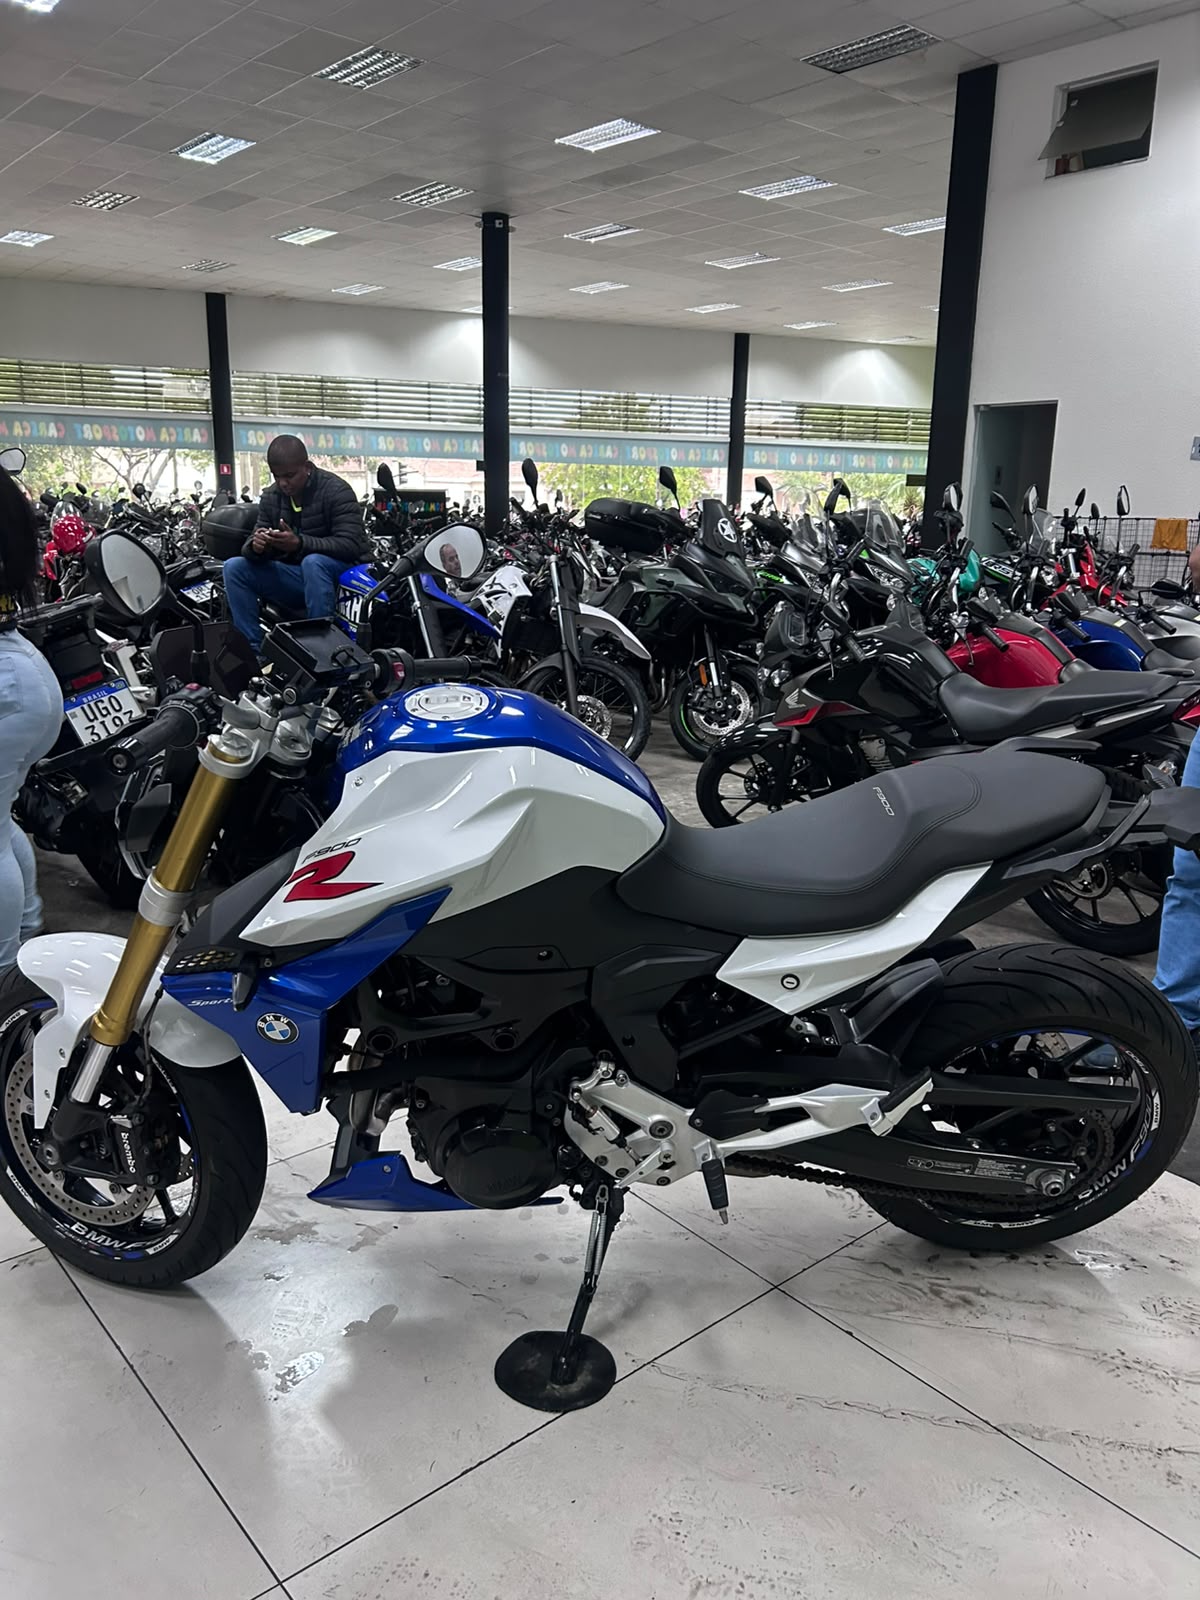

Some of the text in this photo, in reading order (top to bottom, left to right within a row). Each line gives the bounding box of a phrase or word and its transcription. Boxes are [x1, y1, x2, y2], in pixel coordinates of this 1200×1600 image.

[82, 690, 108, 703] BRASIL
[872, 786, 895, 816] F900
[302, 837, 363, 865] F900
[257, 1014, 289, 1029] BMW
[121, 1132, 136, 1174] brembo
[70, 1221, 126, 1250] BMW
